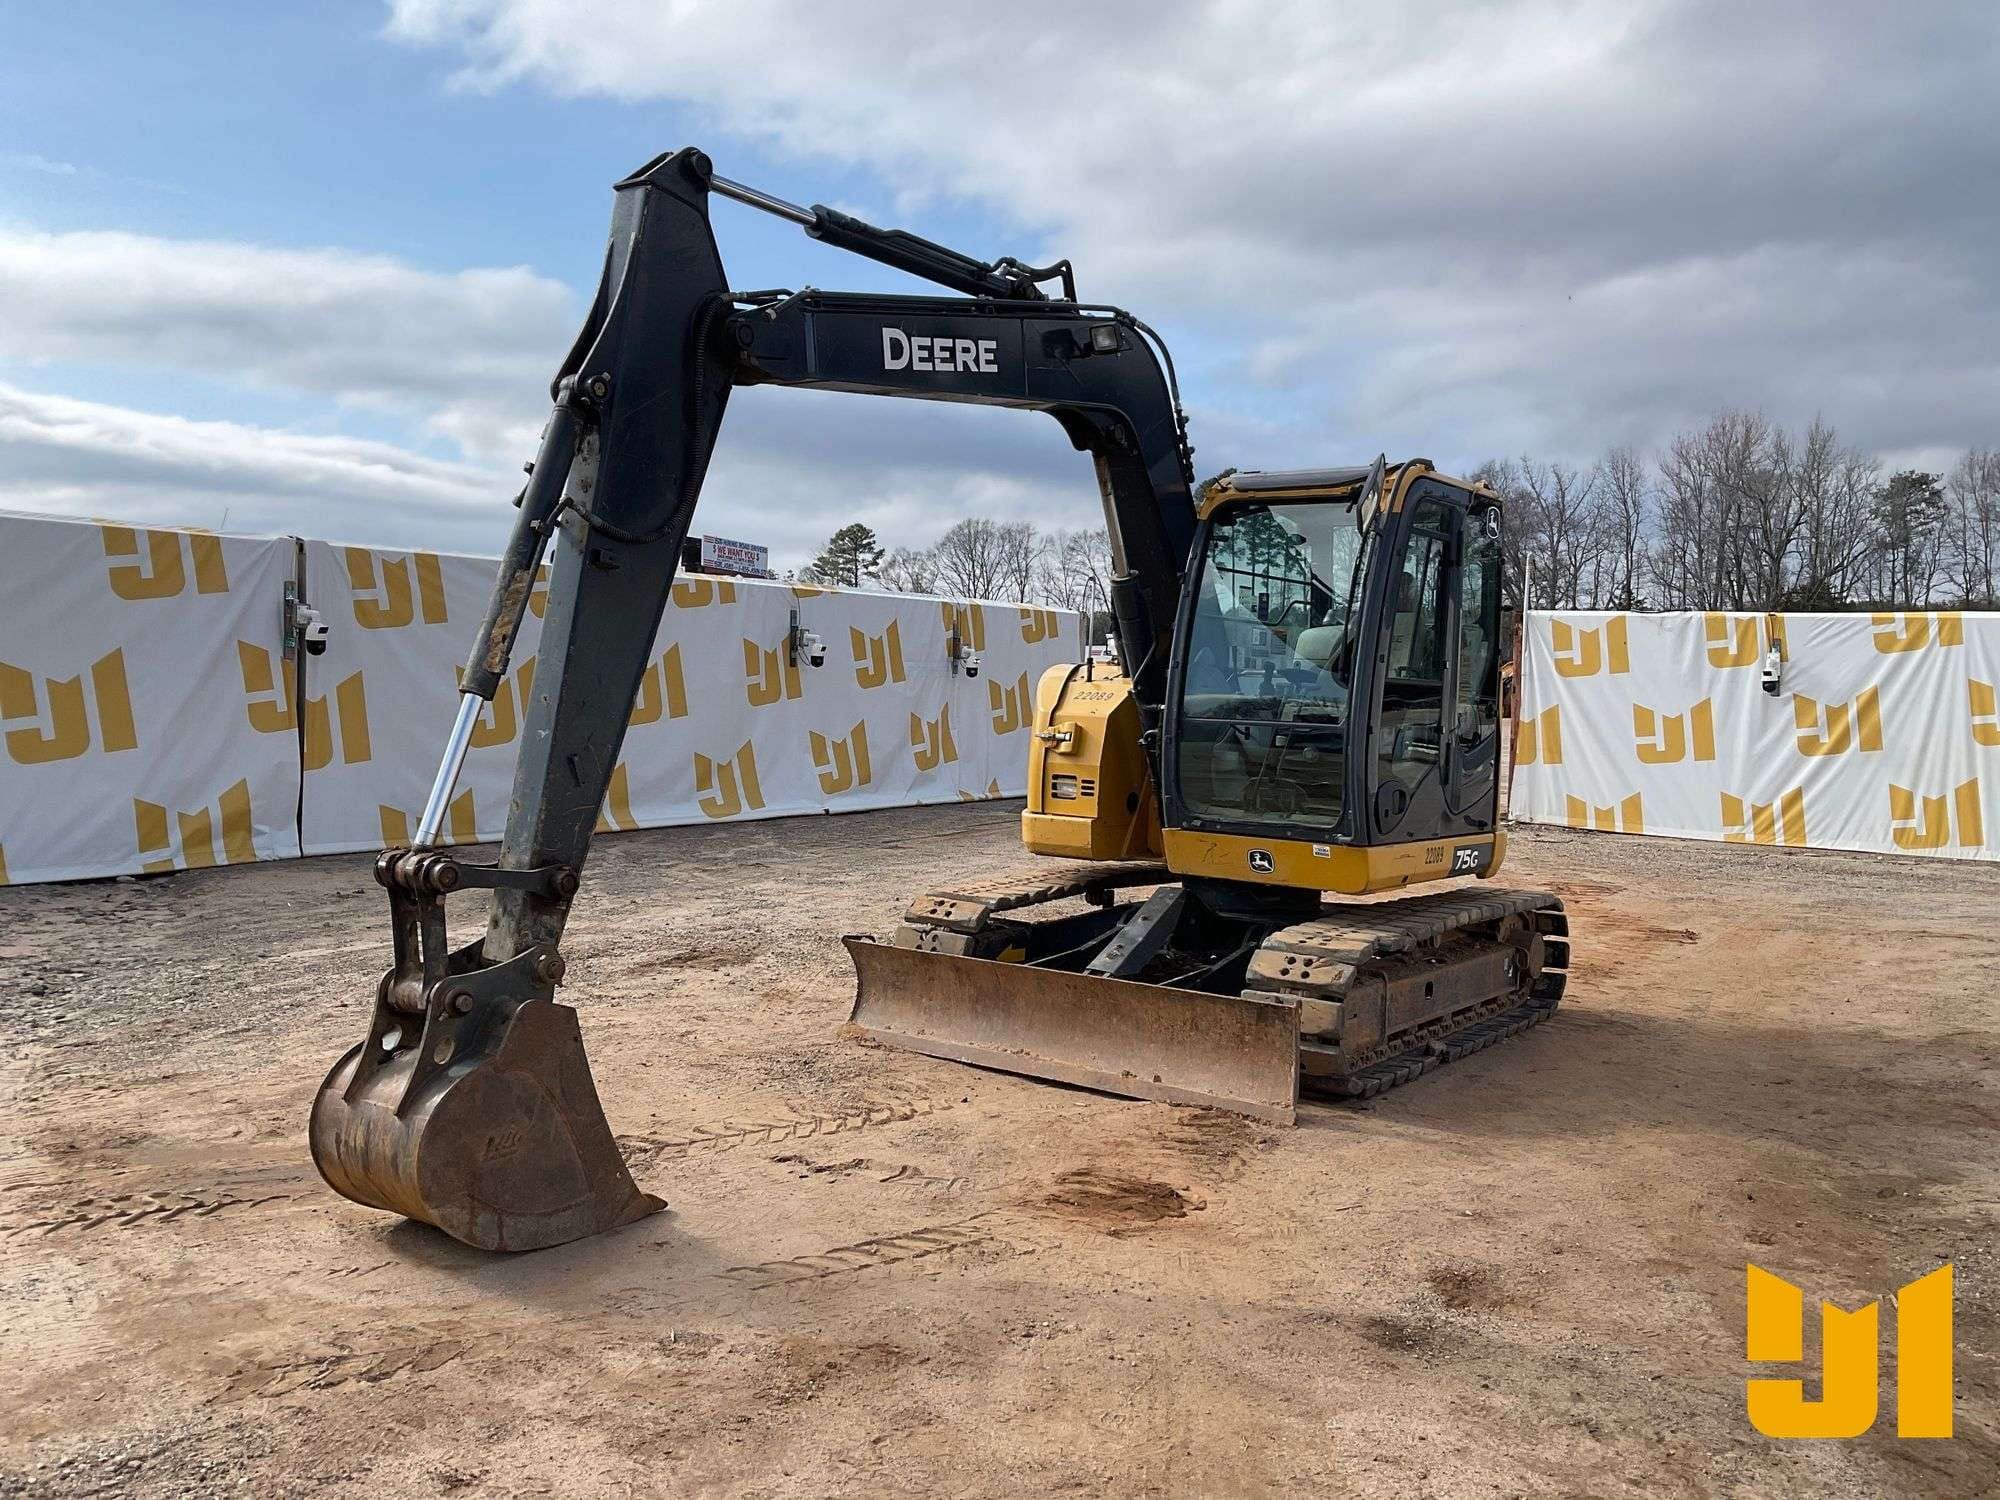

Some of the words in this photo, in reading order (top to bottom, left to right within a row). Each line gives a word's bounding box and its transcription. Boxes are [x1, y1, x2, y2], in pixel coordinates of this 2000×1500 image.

[882, 327, 998, 372] DEERE
[727, 547, 743, 558] WANT
[1073, 691, 1114, 701] 22089
[1454, 849, 1478, 870] 75G
